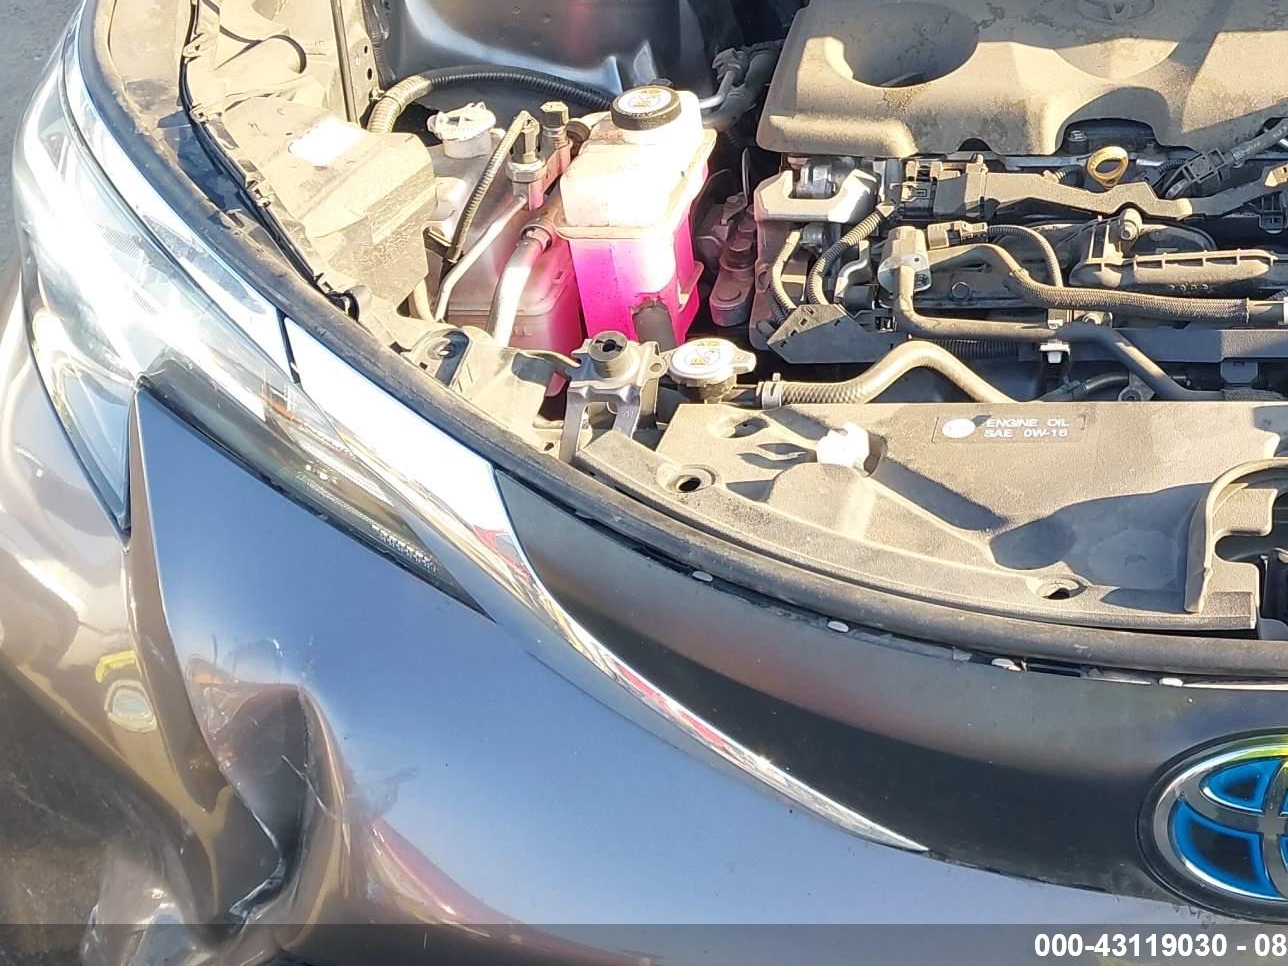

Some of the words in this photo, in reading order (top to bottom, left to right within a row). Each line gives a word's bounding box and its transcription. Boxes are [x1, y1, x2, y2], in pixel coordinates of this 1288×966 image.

[986, 418, 1039, 428] ENGINE
[1047, 418, 1070, 428] OIL
[983, 429, 1013, 438] SAE
[1023, 429, 1069, 438] 0W-16
